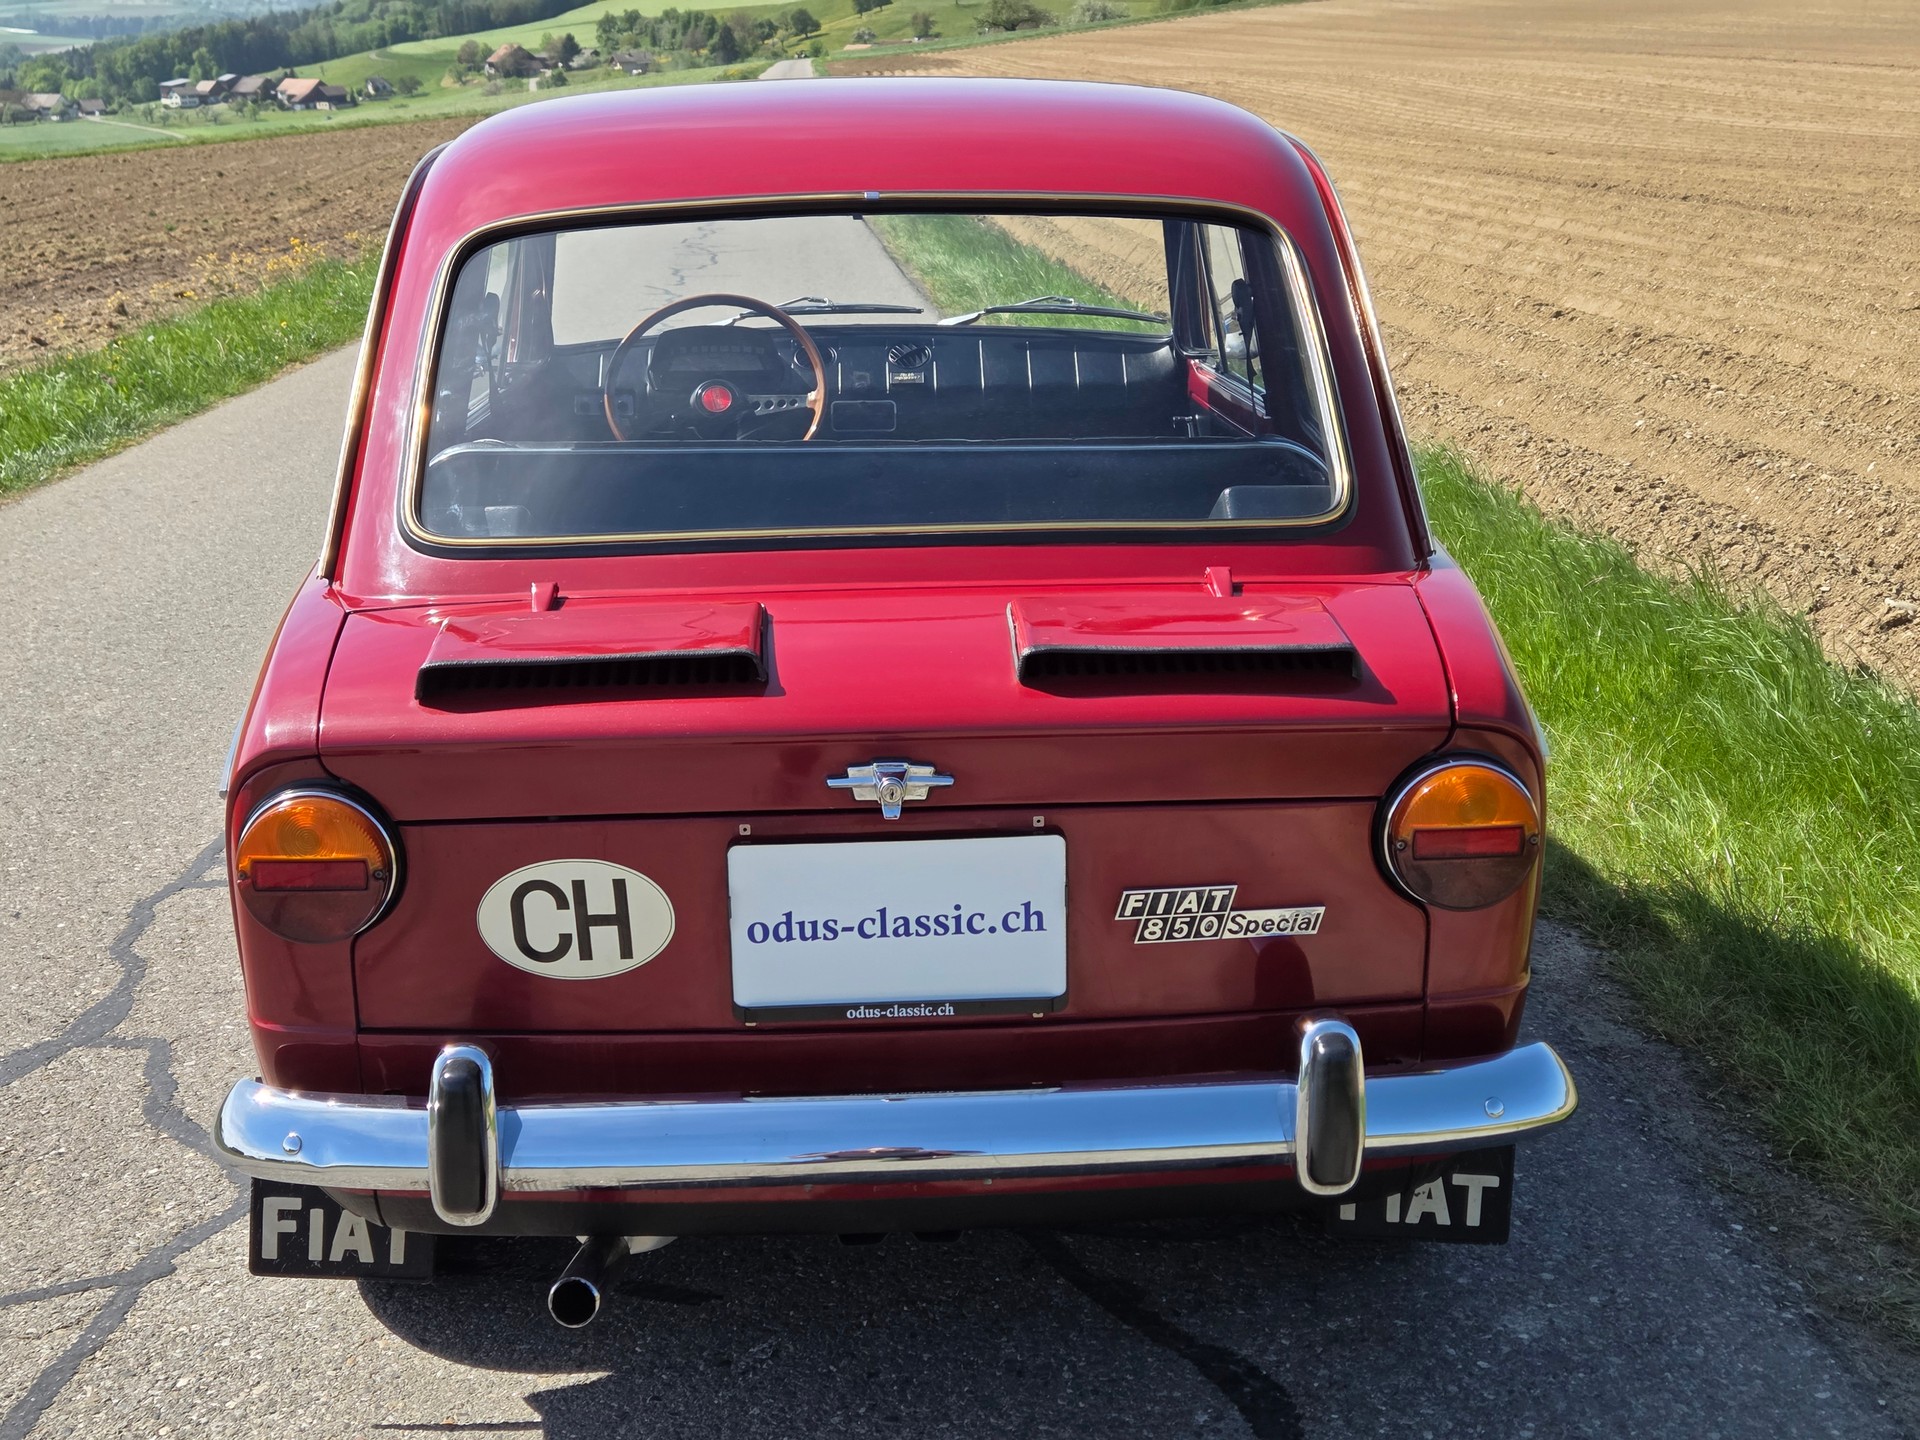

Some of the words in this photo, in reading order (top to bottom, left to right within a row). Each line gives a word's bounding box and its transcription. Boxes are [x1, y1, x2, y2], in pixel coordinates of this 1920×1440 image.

[510, 878, 634, 963] CH
[1123, 889, 1230, 917] FIAT
[747, 901, 1047, 944] odus-classic.ch
[1143, 916, 1219, 940] 850
[1227, 911, 1321, 936] Special
[846, 1003, 955, 1019] odus-classic.ch
[1340, 1173, 1500, 1227] IAT
